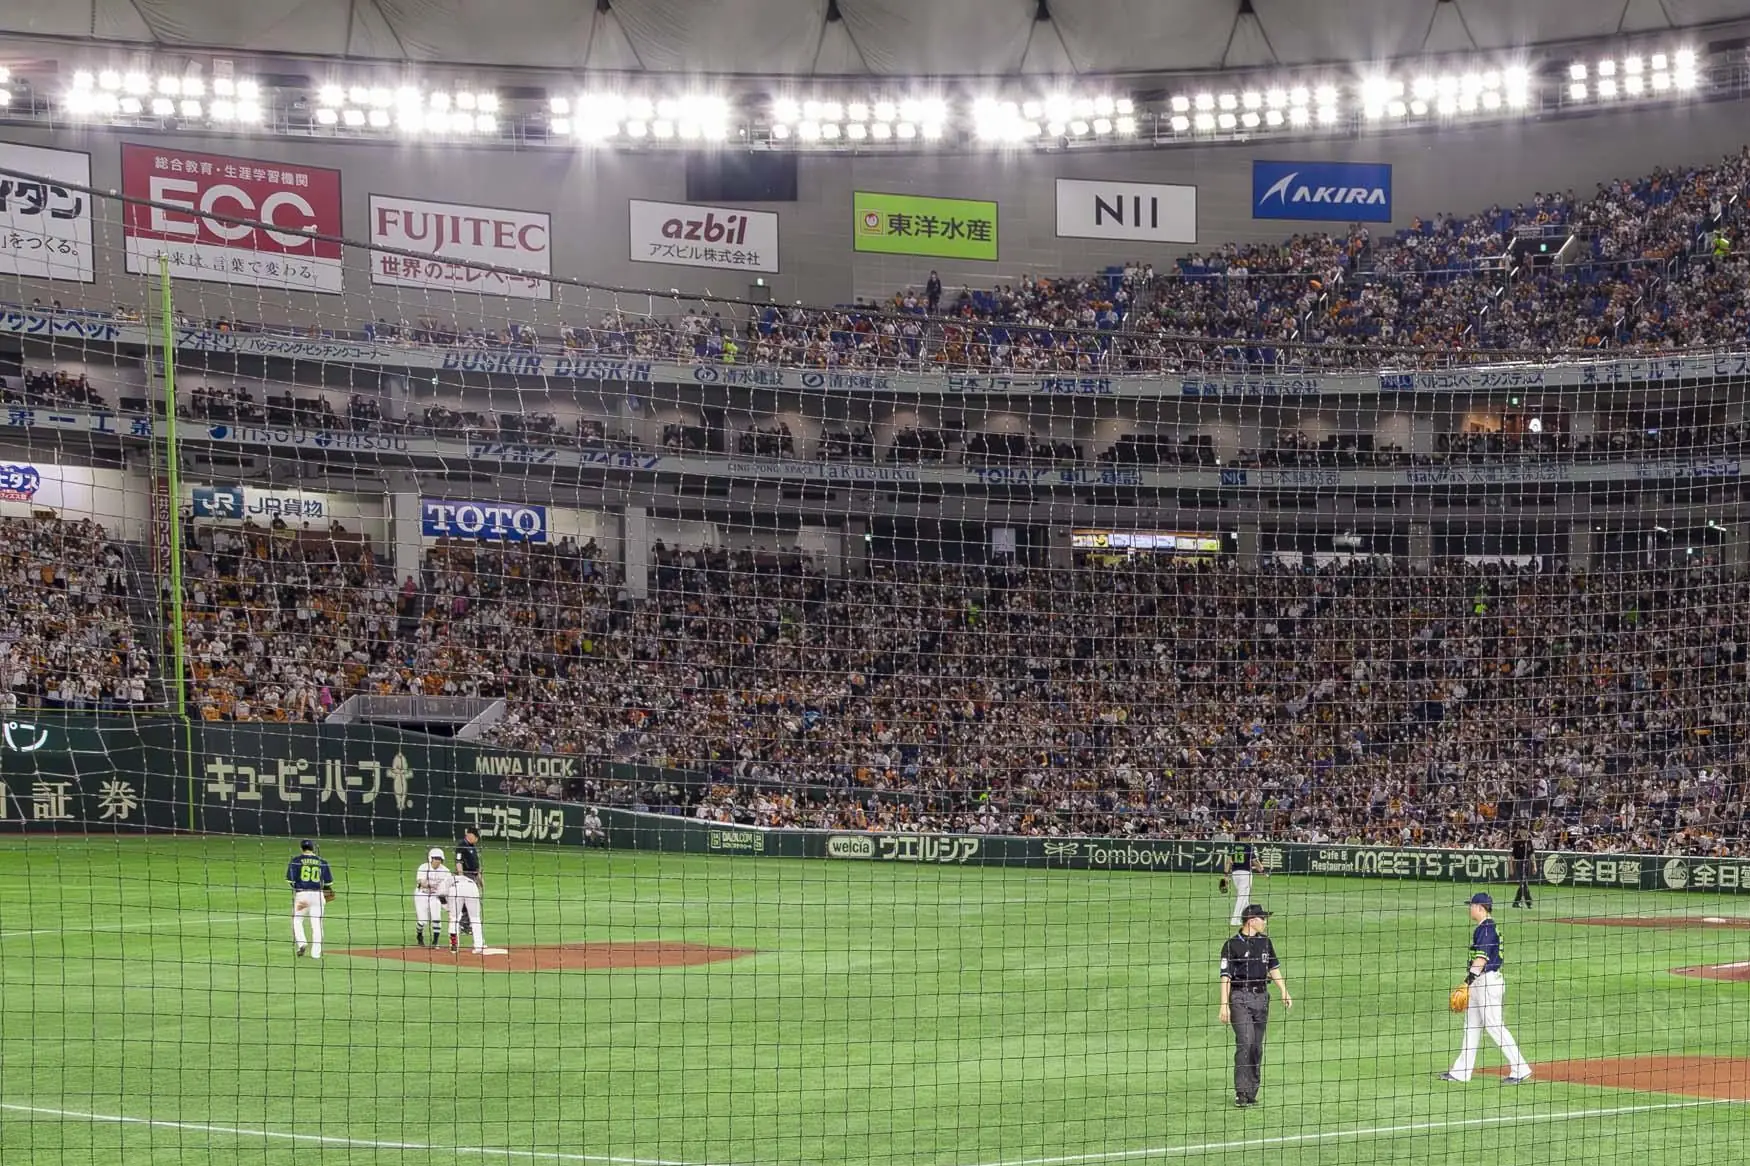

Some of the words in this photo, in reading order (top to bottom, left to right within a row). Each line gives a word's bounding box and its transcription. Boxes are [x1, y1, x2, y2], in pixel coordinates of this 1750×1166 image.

[154, 155, 310, 188] 総合教育・生涯学習機関
[150, 175, 317, 247] ECC
[1291, 187, 1387, 206] AKIRA
[1095, 193, 1158, 230] NII
[376, 207, 547, 252] FUJITEC
[661, 213, 748, 247] azbil
[887, 211, 993, 242] 東洋水産
[649, 243, 762, 268] アズビル株式会社
[442, 350, 544, 376] DUSKIN
[554, 359, 652, 382] DUSKIN
[202, 492, 235, 512] JR
[427, 503, 542, 535] TOTO
[207, 757, 381, 802] キューピーハーフ
[475, 756, 523, 775] MIWA
[528, 758, 574, 777] LOCK
[880, 836, 979, 863] ウエルシア
[1085, 844, 1171, 866] Tombow
[1311, 859, 1354, 872] Restaurant
[1355, 850, 1442, 877] MEETS
[300, 865, 321, 882] 60
[1571, 858, 1642, 885] 全日警
